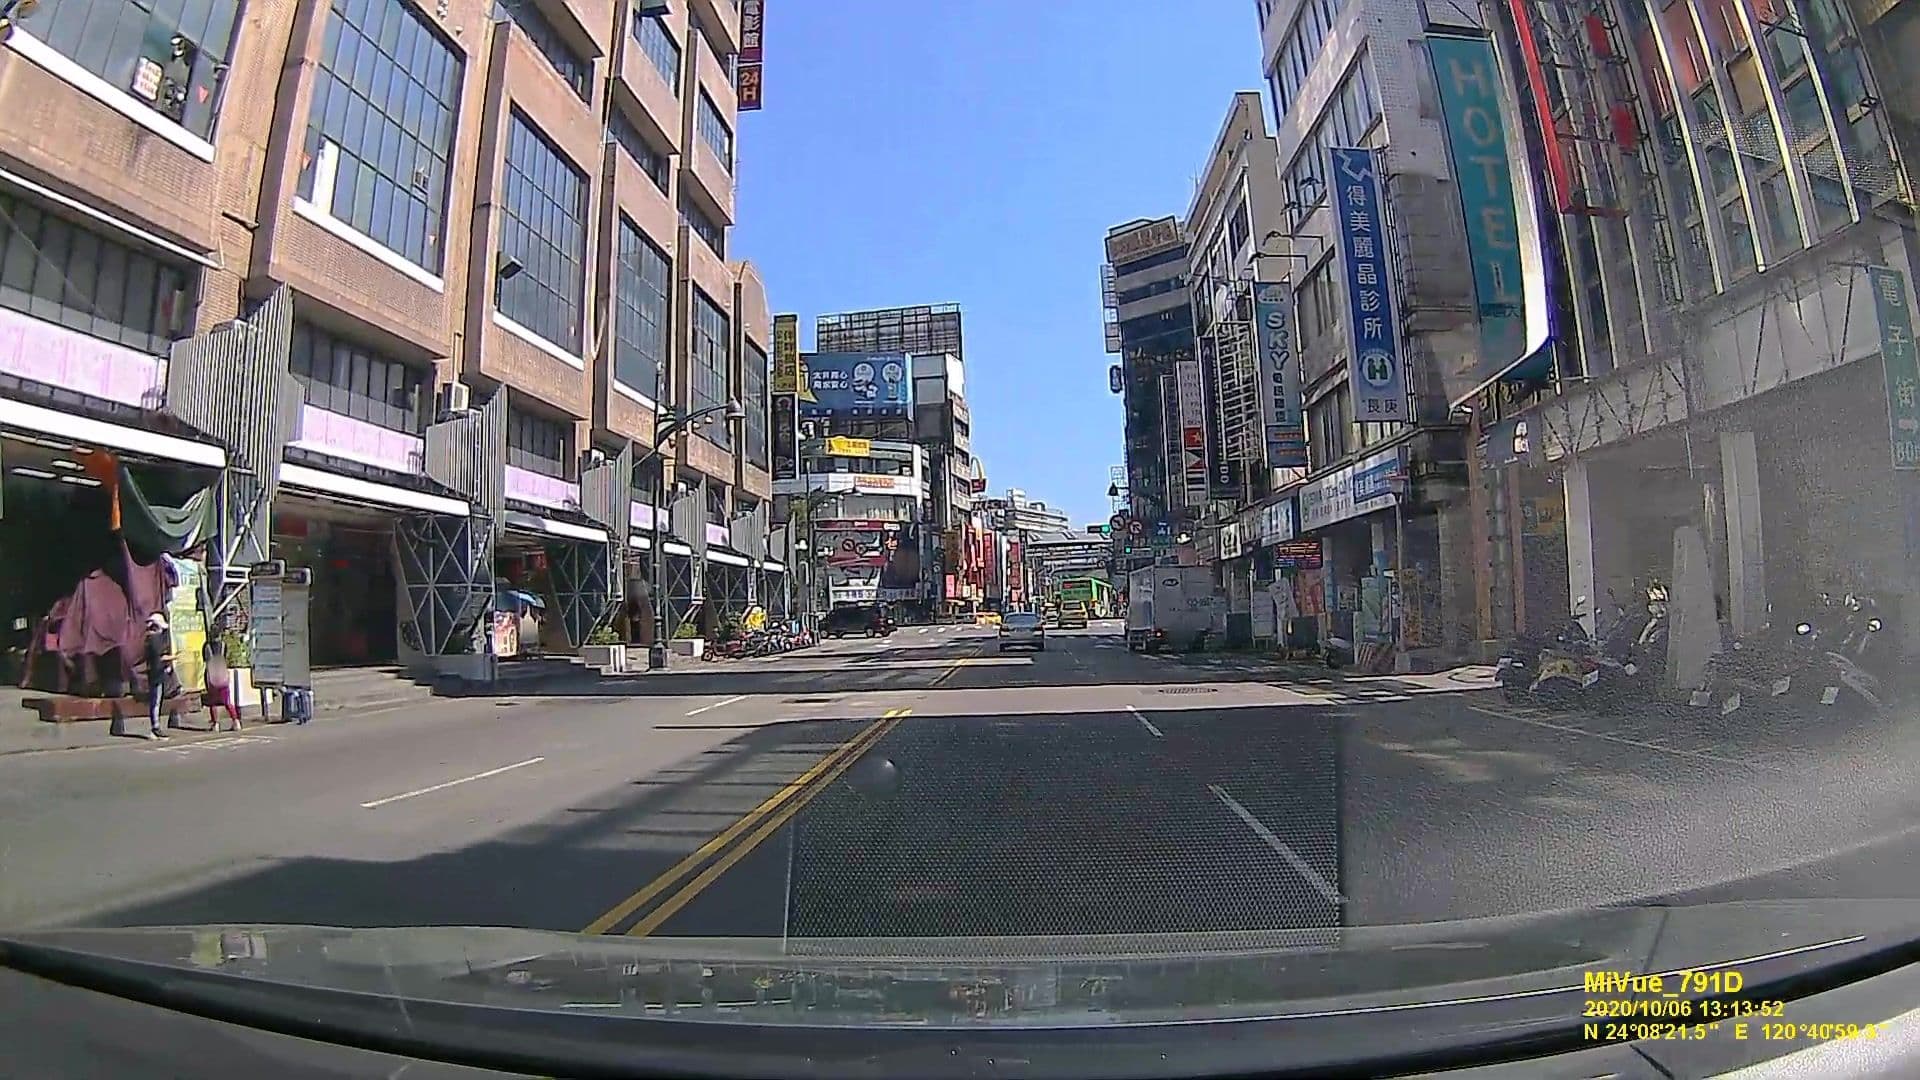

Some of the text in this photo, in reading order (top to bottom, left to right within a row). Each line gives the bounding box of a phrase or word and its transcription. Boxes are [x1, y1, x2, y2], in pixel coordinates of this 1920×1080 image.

[1447, 57, 1519, 304] HOTEL
[1265, 311, 1290, 371] SKY
[1346, 184, 1385, 341] 得美麗晶診所
